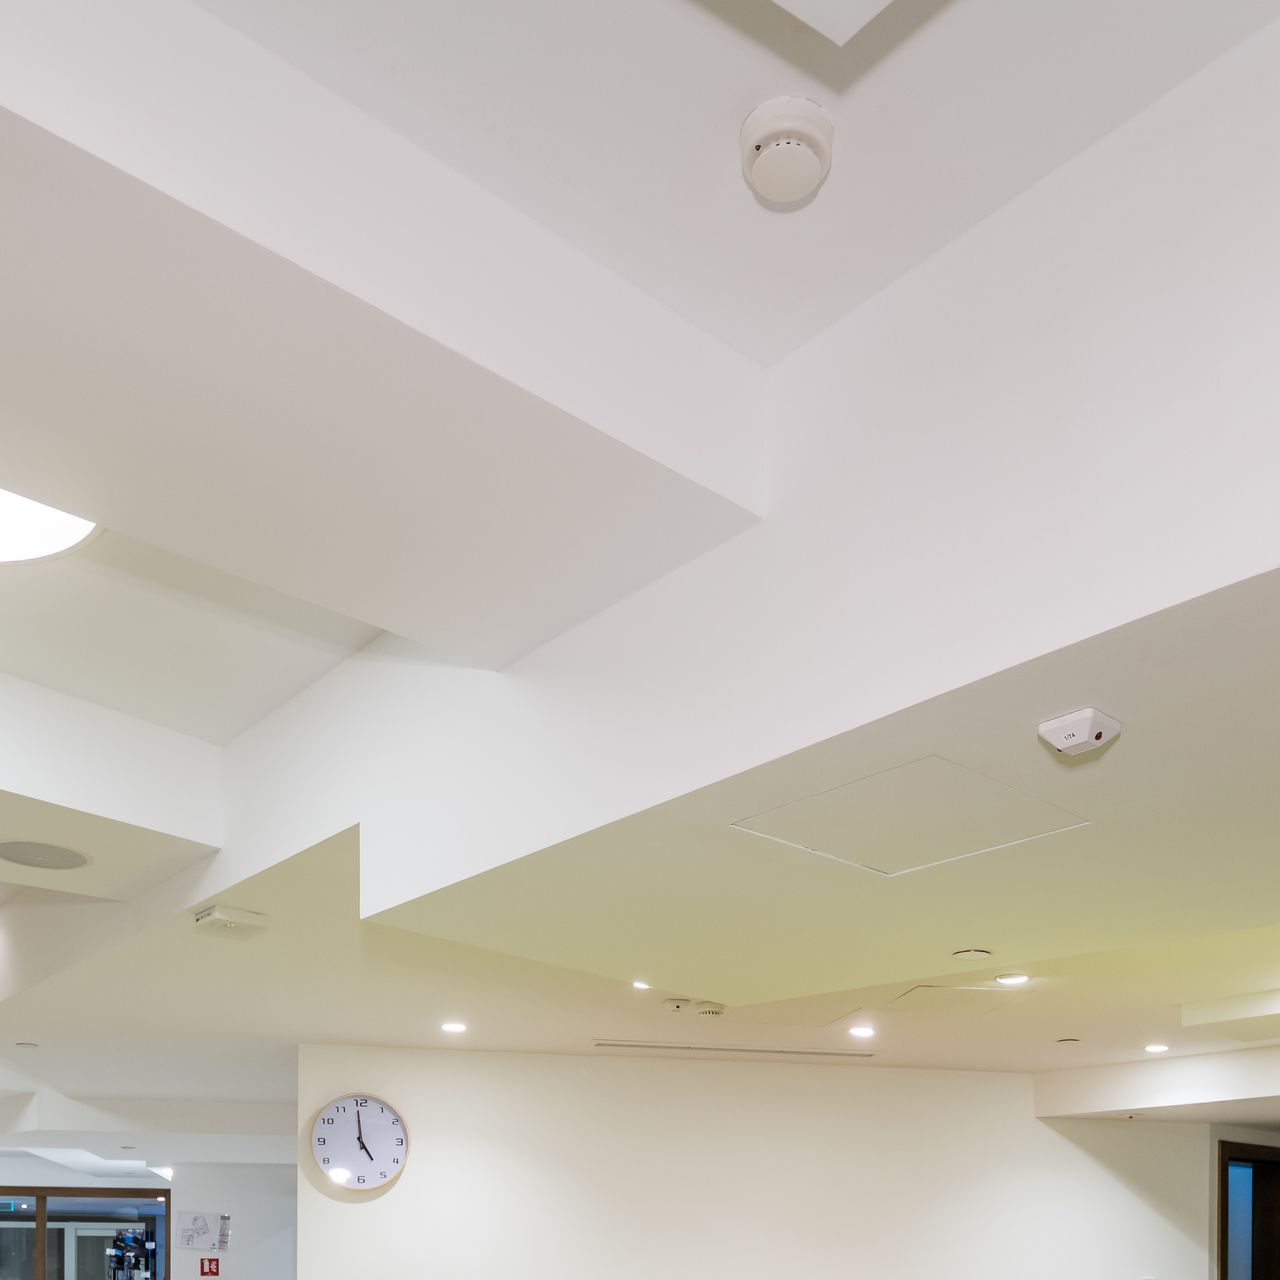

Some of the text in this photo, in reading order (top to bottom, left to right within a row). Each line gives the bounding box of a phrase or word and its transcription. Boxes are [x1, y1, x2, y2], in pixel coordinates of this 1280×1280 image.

[354, 1099, 368, 1107] 12
[317, 1137, 326, 1146] 9
[395, 1138, 404, 1146] 3
[357, 1176, 366, 1184] 6
